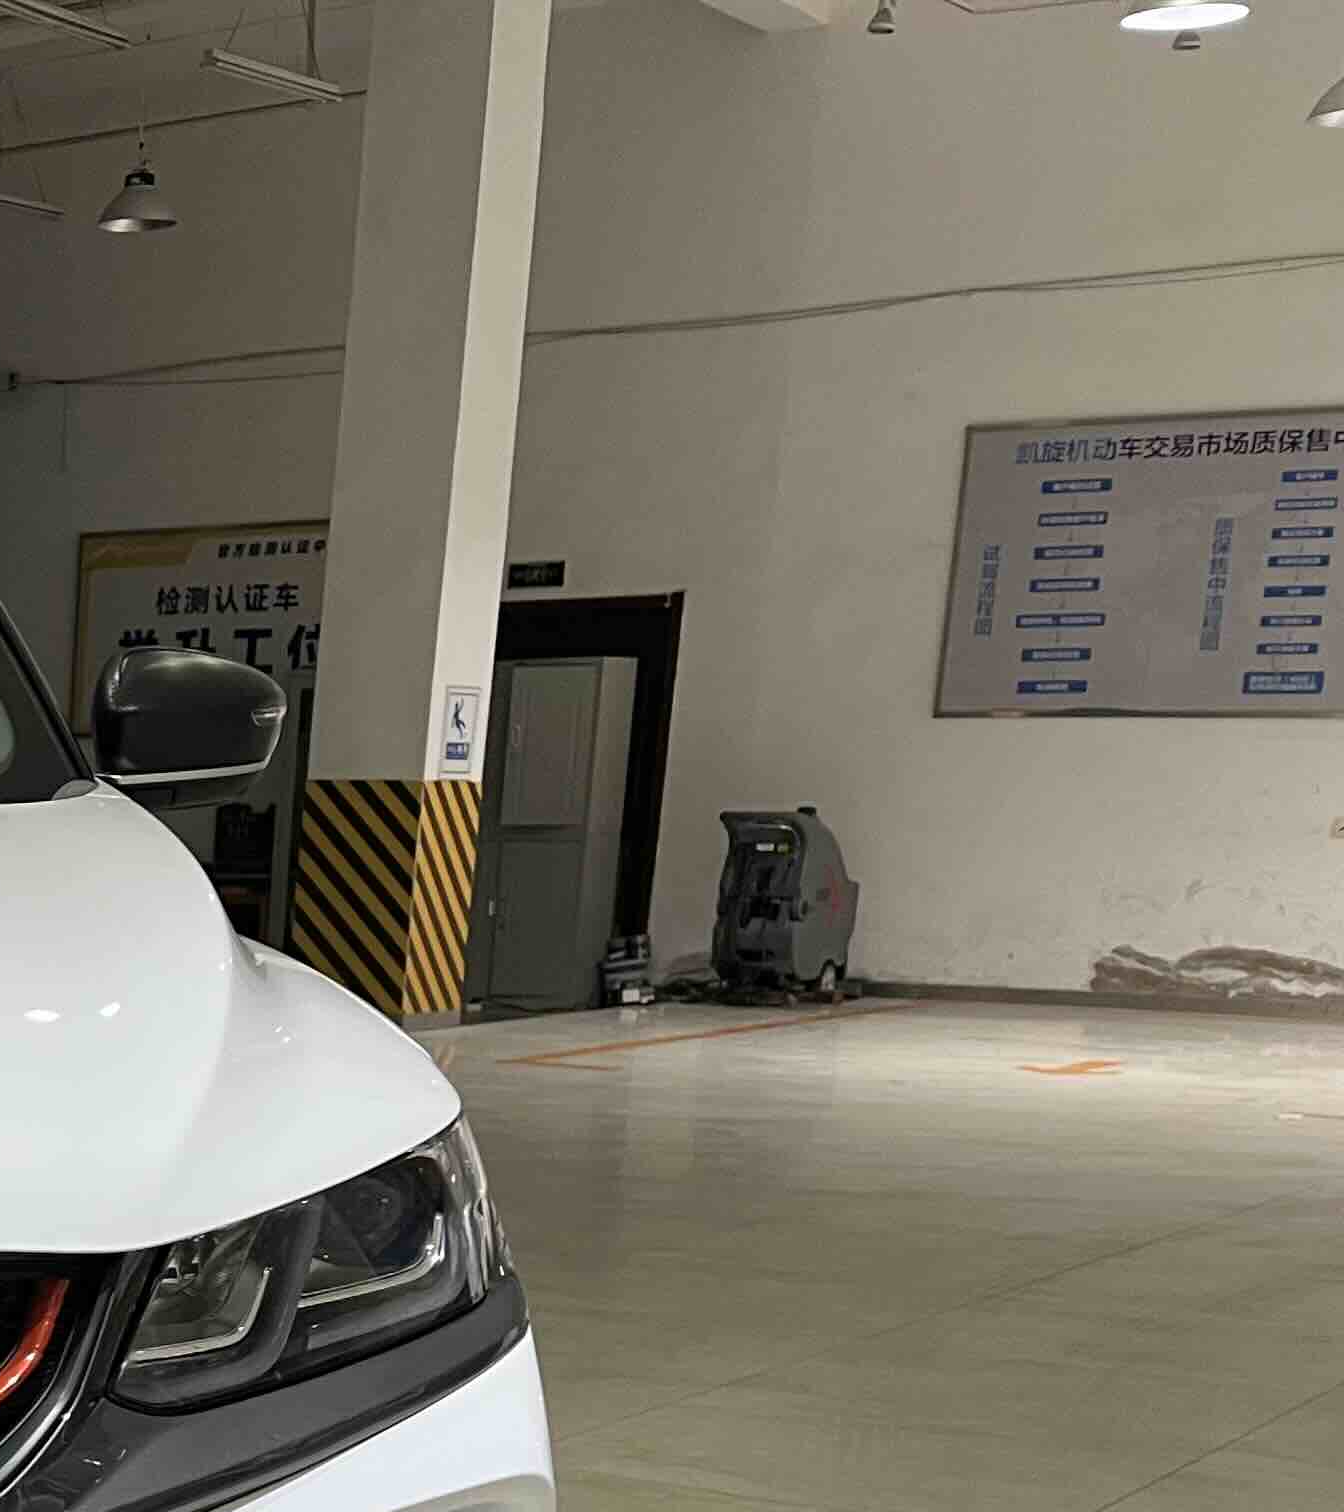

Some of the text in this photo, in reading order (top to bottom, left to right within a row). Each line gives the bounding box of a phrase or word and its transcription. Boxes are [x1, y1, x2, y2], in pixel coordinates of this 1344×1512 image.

[155, 582, 300, 615] 检测认证车
